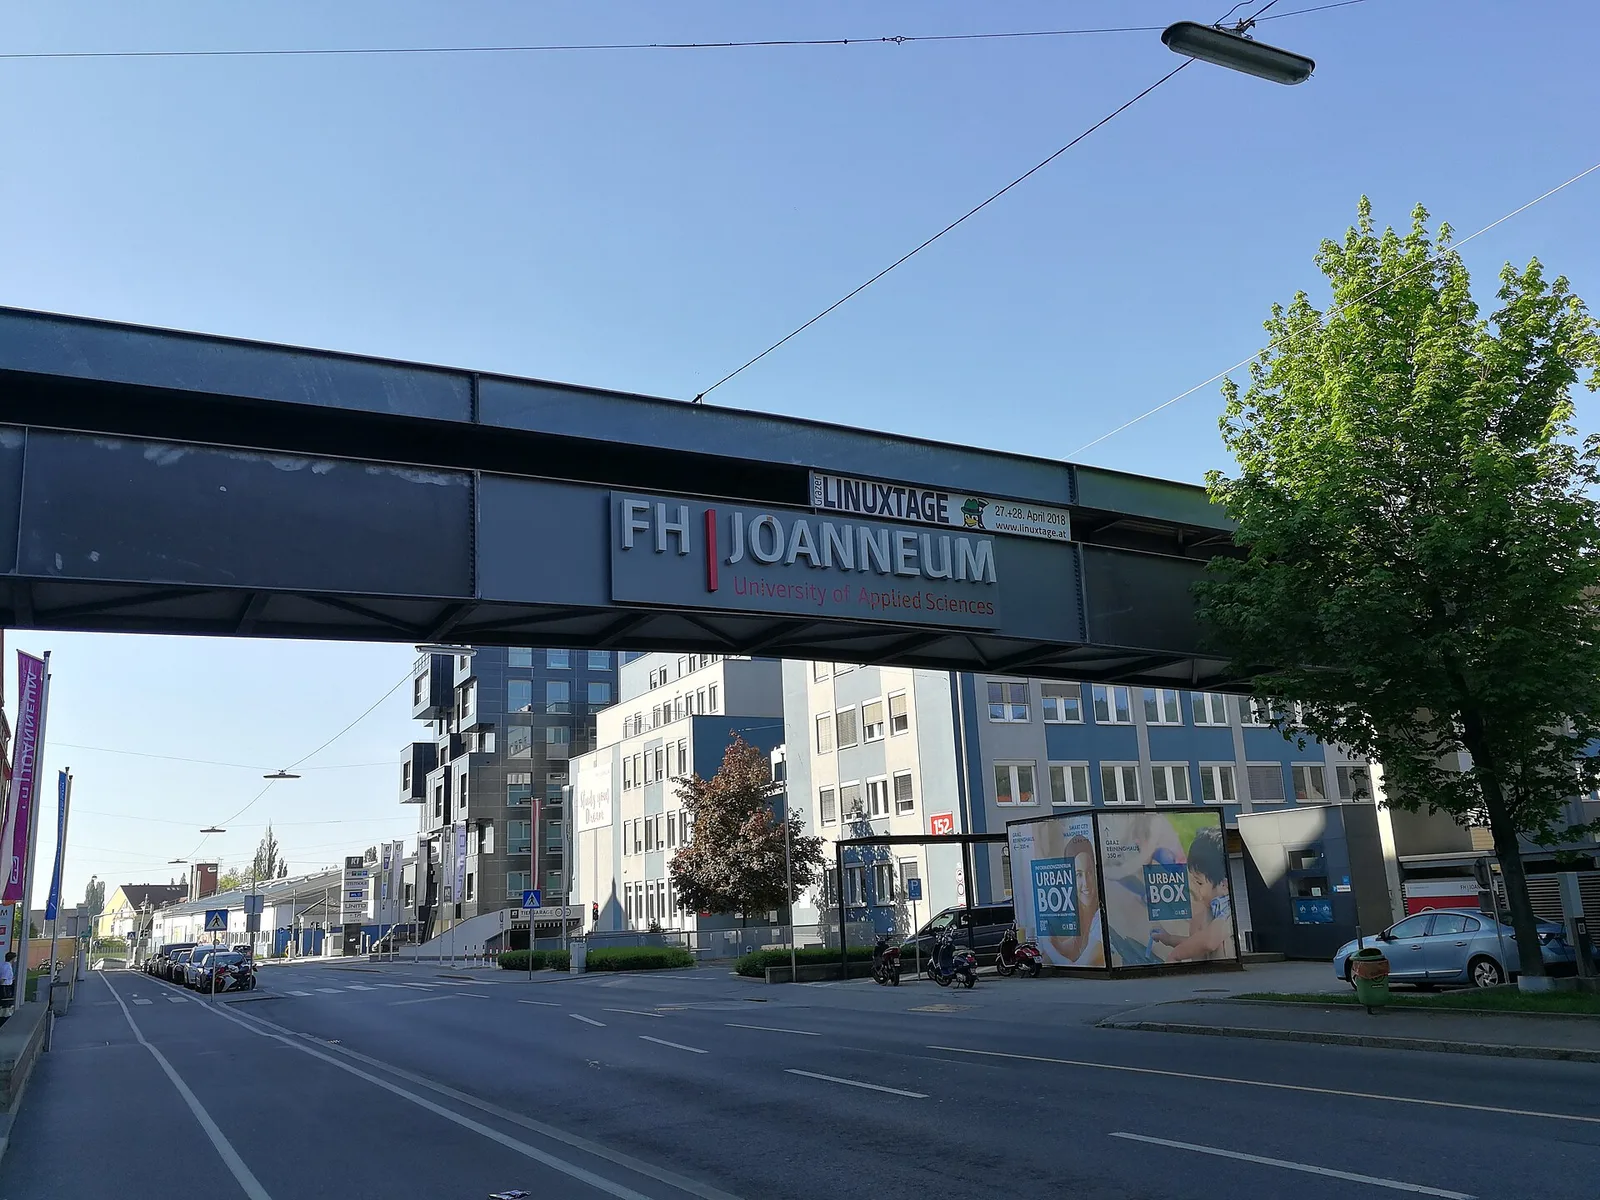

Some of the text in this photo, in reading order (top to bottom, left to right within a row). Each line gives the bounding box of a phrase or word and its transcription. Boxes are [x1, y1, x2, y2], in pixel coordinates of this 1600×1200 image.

[814, 475, 823, 506] Grazer
[823, 476, 950, 524] LINUXTAGE
[994, 505, 1066, 526] 27.+28. April 2018
[995, 521, 1067, 539] www.linuxtage.at
[621, 498, 997, 585] FH JOANNEUM
[733, 576, 995, 616] University of Applied Sciences
[933, 818, 951, 835] 152
[910, 880, 919, 891] P
[1035, 869, 1074, 887] URBAN
[1148, 871, 1185, 884] URBAN
[1037, 886, 1076, 912] BOX
[1149, 884, 1187, 904] BOX
